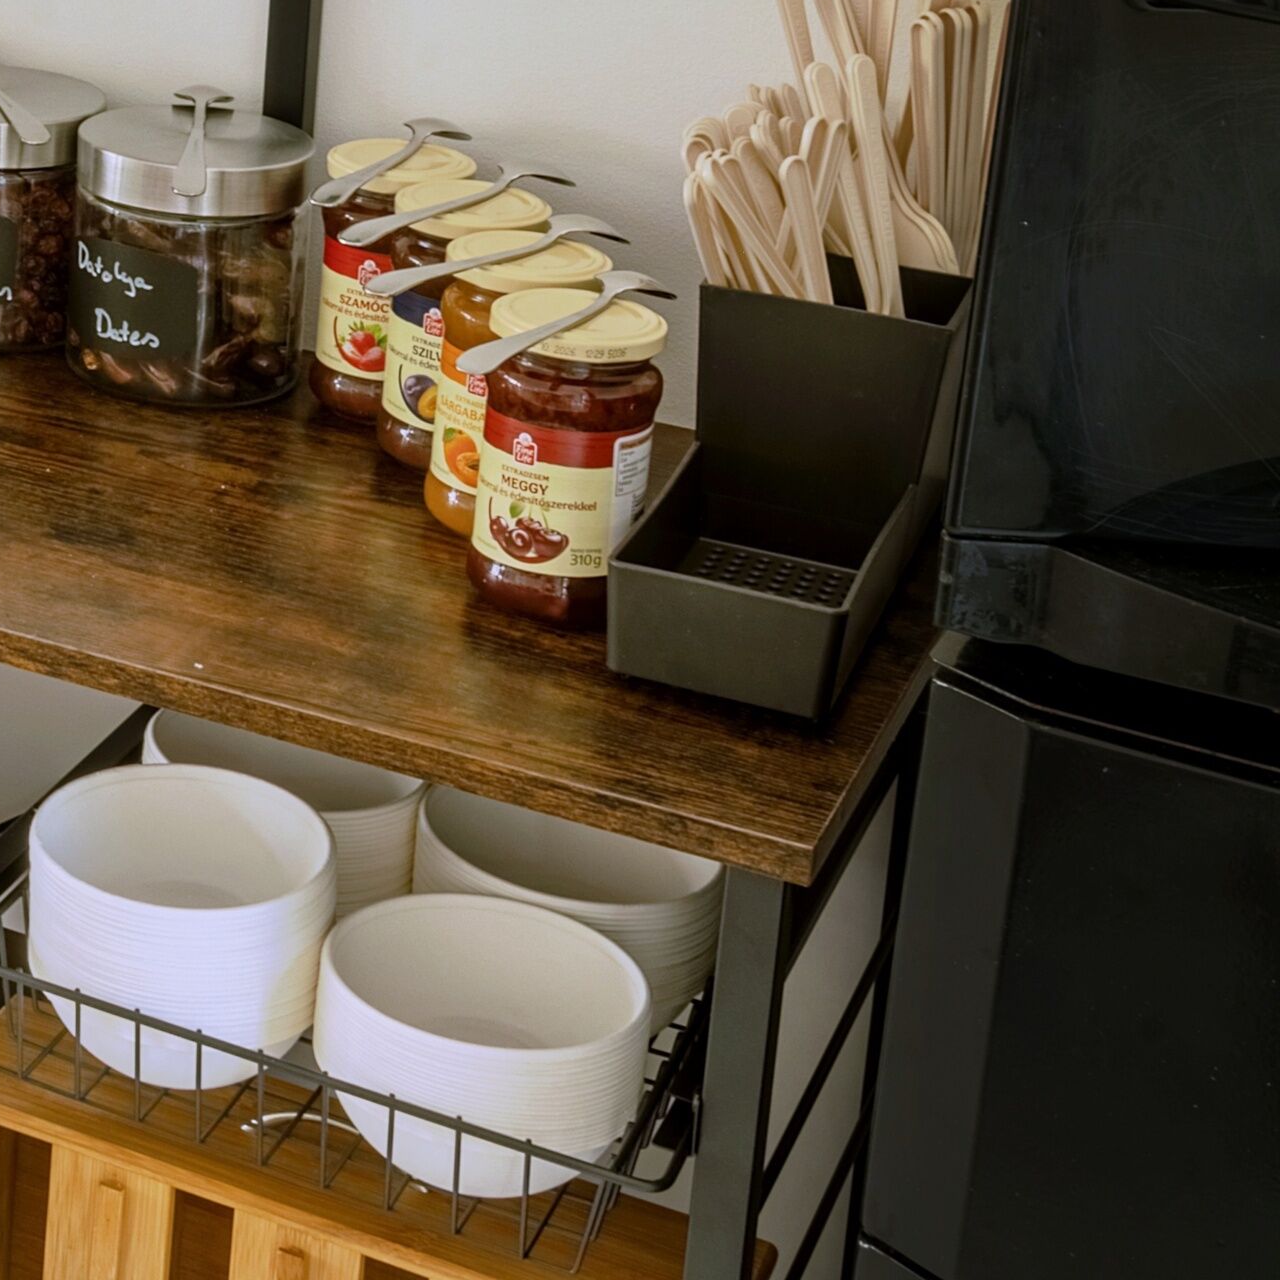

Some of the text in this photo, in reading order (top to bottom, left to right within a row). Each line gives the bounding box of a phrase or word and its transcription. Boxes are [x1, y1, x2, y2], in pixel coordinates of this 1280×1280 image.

[339, 293, 390, 314] SZAMÓC
[515, 443, 535, 455] Fine
[516, 451, 533, 464] Life
[501, 474, 549, 496] MEGGY
